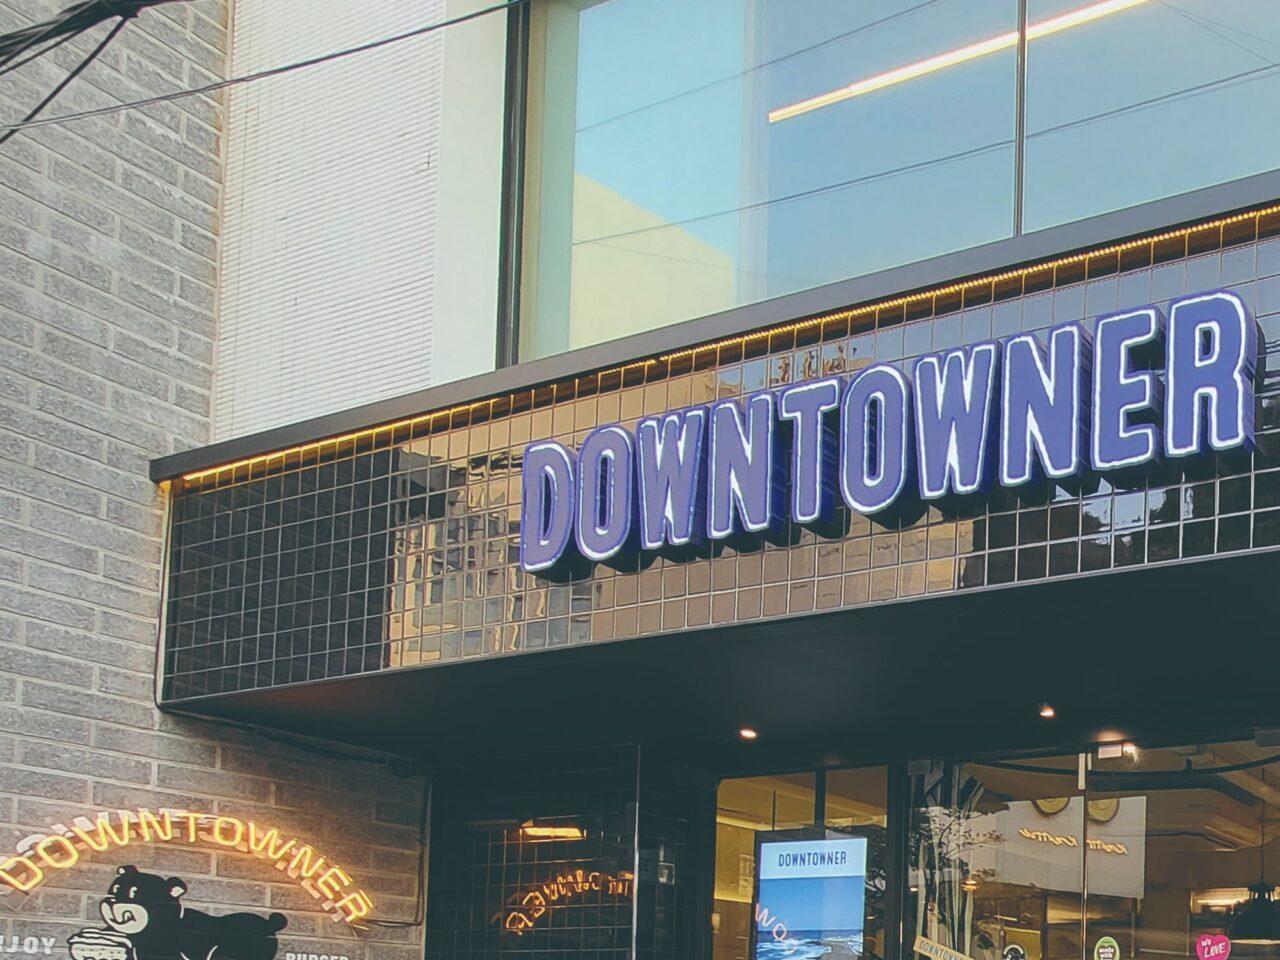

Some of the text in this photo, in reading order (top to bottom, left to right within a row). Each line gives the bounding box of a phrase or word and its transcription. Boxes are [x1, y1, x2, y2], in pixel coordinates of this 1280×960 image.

[520, 291, 1258, 573] DOWNTOWNER
[778, 851, 847, 867] DOWNTOWNER
[0, 810, 374, 930] DOWNTOWNER
[0, 935, 56, 955] JOY
[1204, 942, 1226, 959] LOVE
